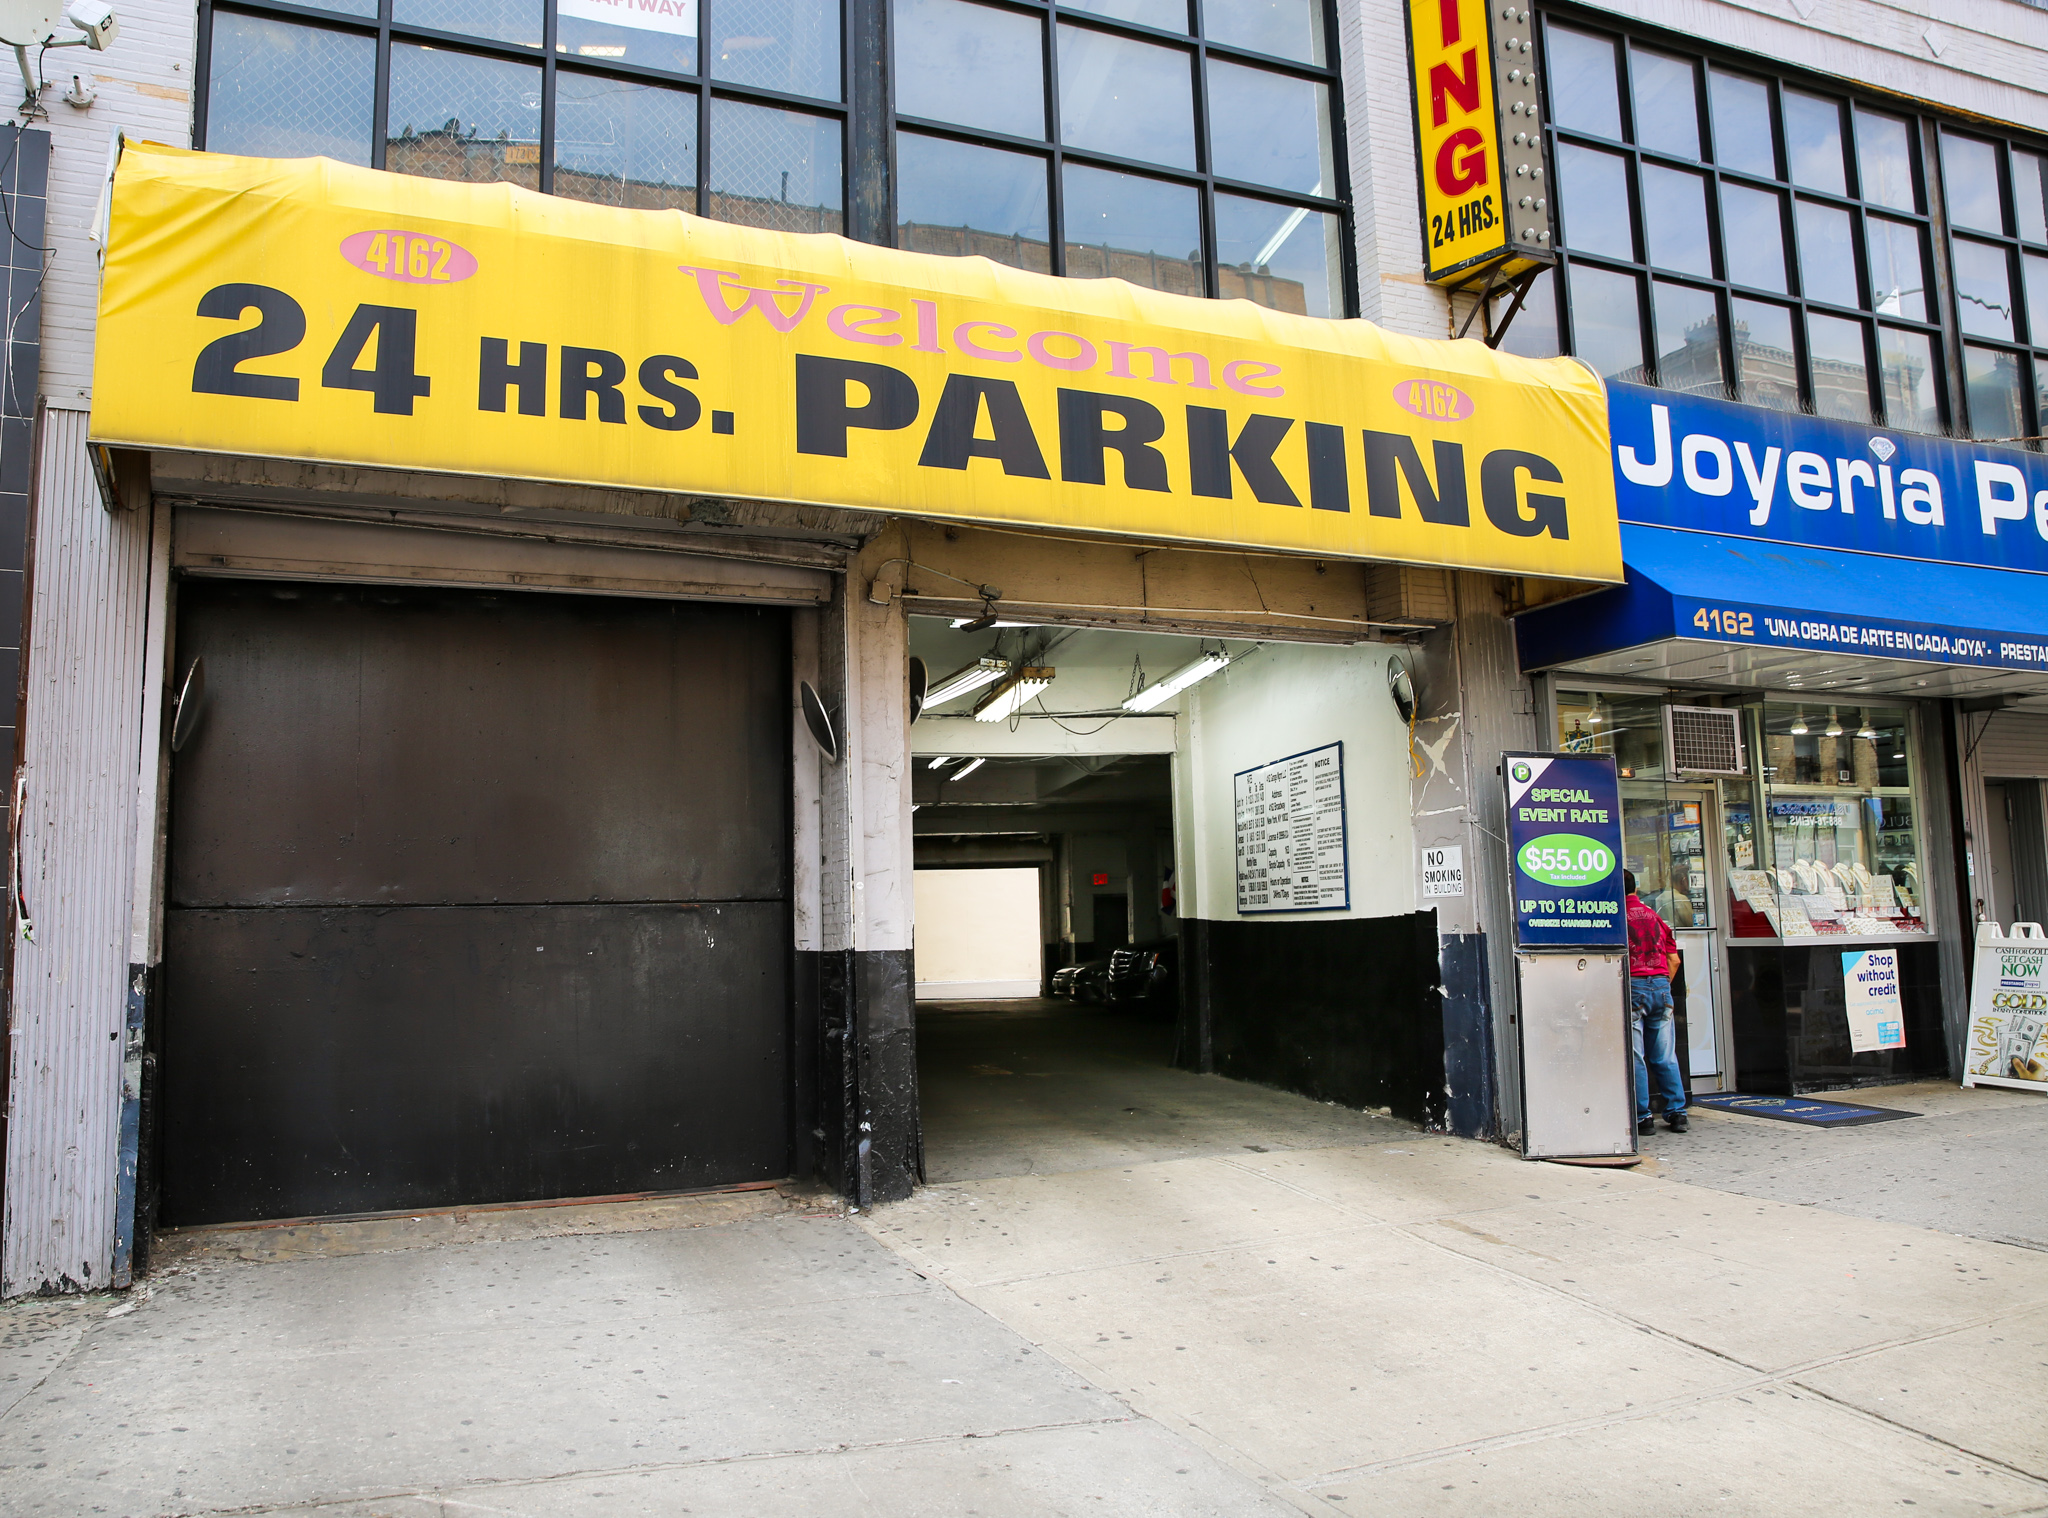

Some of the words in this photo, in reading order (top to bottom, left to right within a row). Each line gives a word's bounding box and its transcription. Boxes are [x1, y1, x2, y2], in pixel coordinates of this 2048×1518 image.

[1432, 210, 1455, 249] 24
[1458, 195, 1499, 239] HRS.
[365, 232, 452, 281] 4162
[677, 265, 1286, 398] Welcome
[1408, 381, 1461, 419] 4162
[191, 282, 431, 416] 24
[478, 336, 735, 435] HRS.
[796, 353, 1569, 541] PARKING
[1617, 403, 1945, 527] Joyeria
[1693, 607, 1755, 636] 4162
[1764, 617, 1800, 639] "UNA
[1800, 621, 1839, 644] OBRA
[1840, 625, 1858, 645] DE
[1860, 627, 1895, 649] ARTE
[1895, 631, 1913, 650] EN
[1914, 633, 1950, 654] CADA
[1315, 757, 1330, 768] NOTICE
[1531, 788, 1594, 803] SPECIAL
[1519, 808, 1567, 822] EVENT
[1570, 809, 1608, 823] RATE
[1427, 850, 1444, 865] NO
[1525, 845, 1608, 873] $55.00
[1424, 869, 1462, 883] SMOKING
[1425, 884, 1431, 894] IN
[1434, 883, 1462, 894] BUILDING
[1519, 900, 1537, 913] UP
[1538, 900, 1556, 914] TO
[1558, 899, 1576, 914] 12
[1577, 901, 1618, 915] HOURS
[1528, 918, 1560, 928] OVERSIZE
[1560, 919, 1592, 928] CHARGES
[1868, 954, 1893, 968] Shop
[2001, 955, 2018, 963] GET
[2019, 955, 2043, 964] CASH
[1857, 969, 1895, 982] without
[2001, 963, 2042, 977] NOW
[1868, 983, 1896, 996] credit
[1992, 993, 2047, 1010] GOLD
